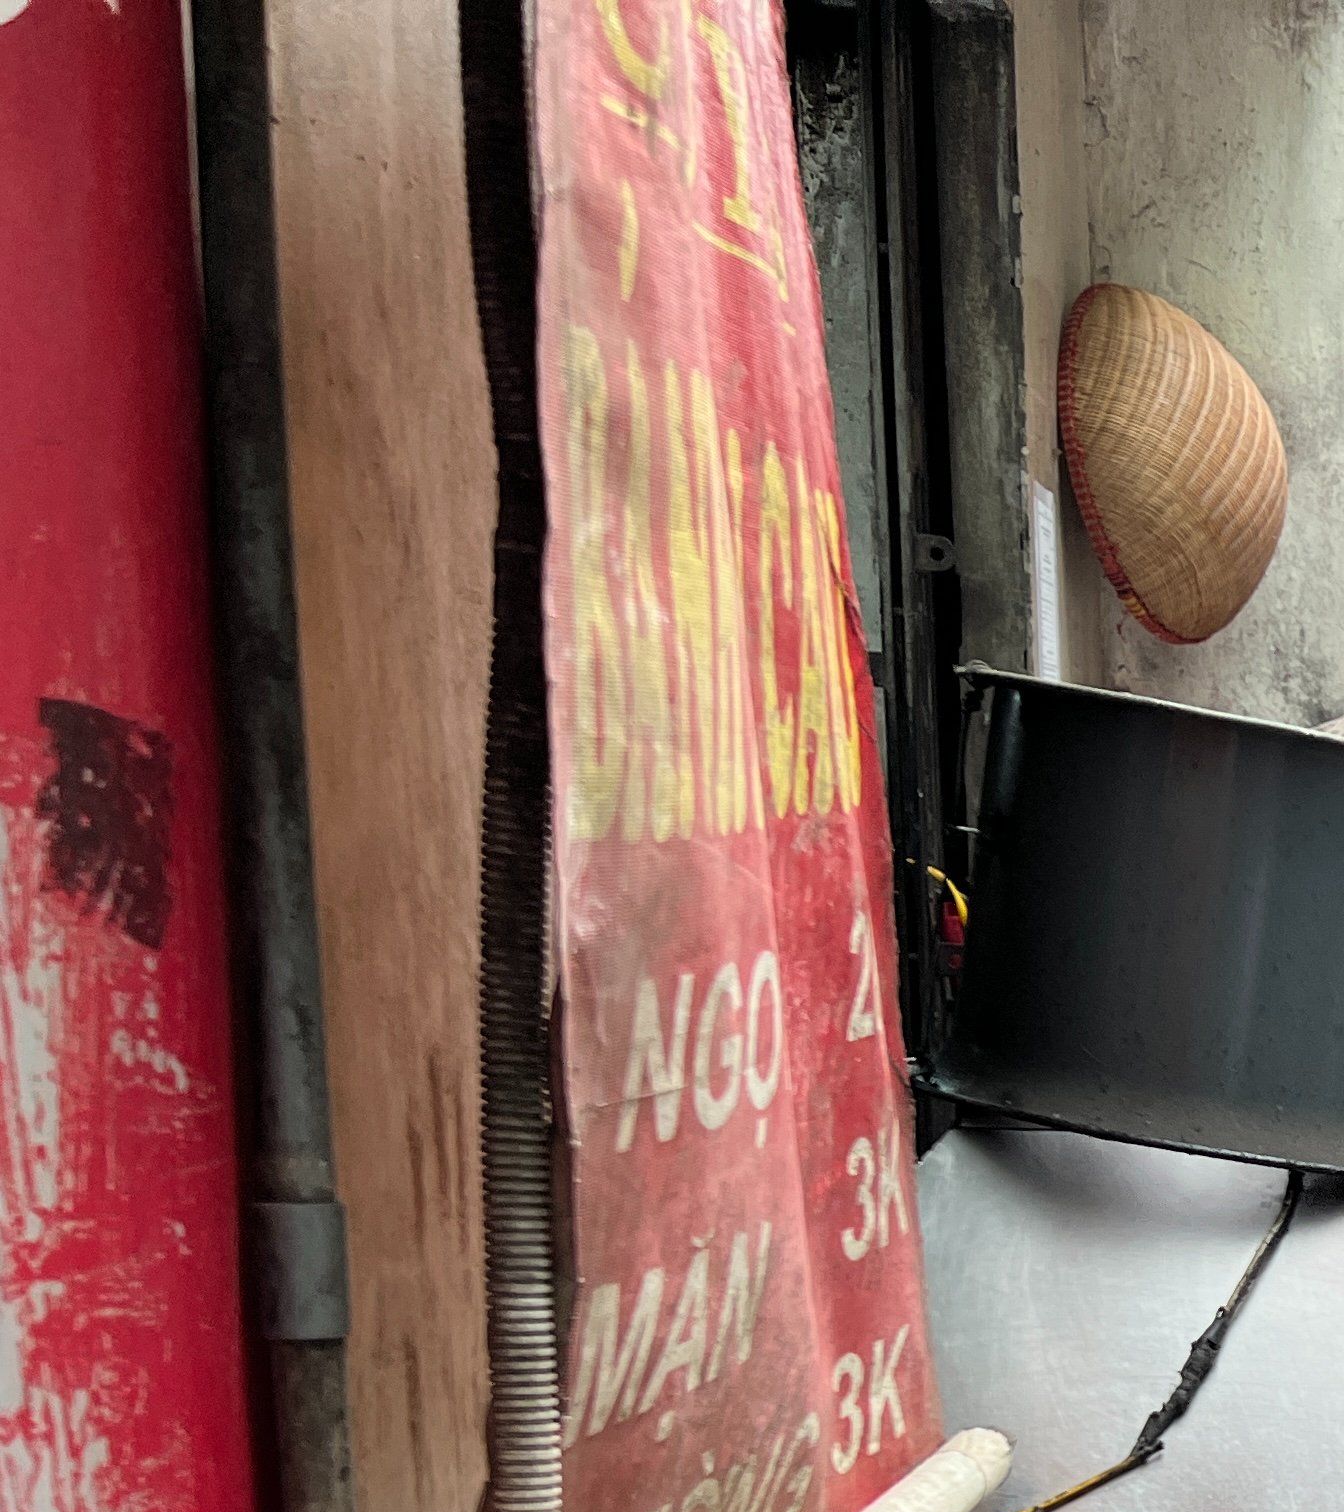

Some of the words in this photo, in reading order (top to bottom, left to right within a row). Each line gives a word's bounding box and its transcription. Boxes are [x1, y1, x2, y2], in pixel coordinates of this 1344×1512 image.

[562, 1220, 772, 1451] MẶN
[841, 1122, 909, 1262] 3K
[831, 1324, 909, 1475] 3K
